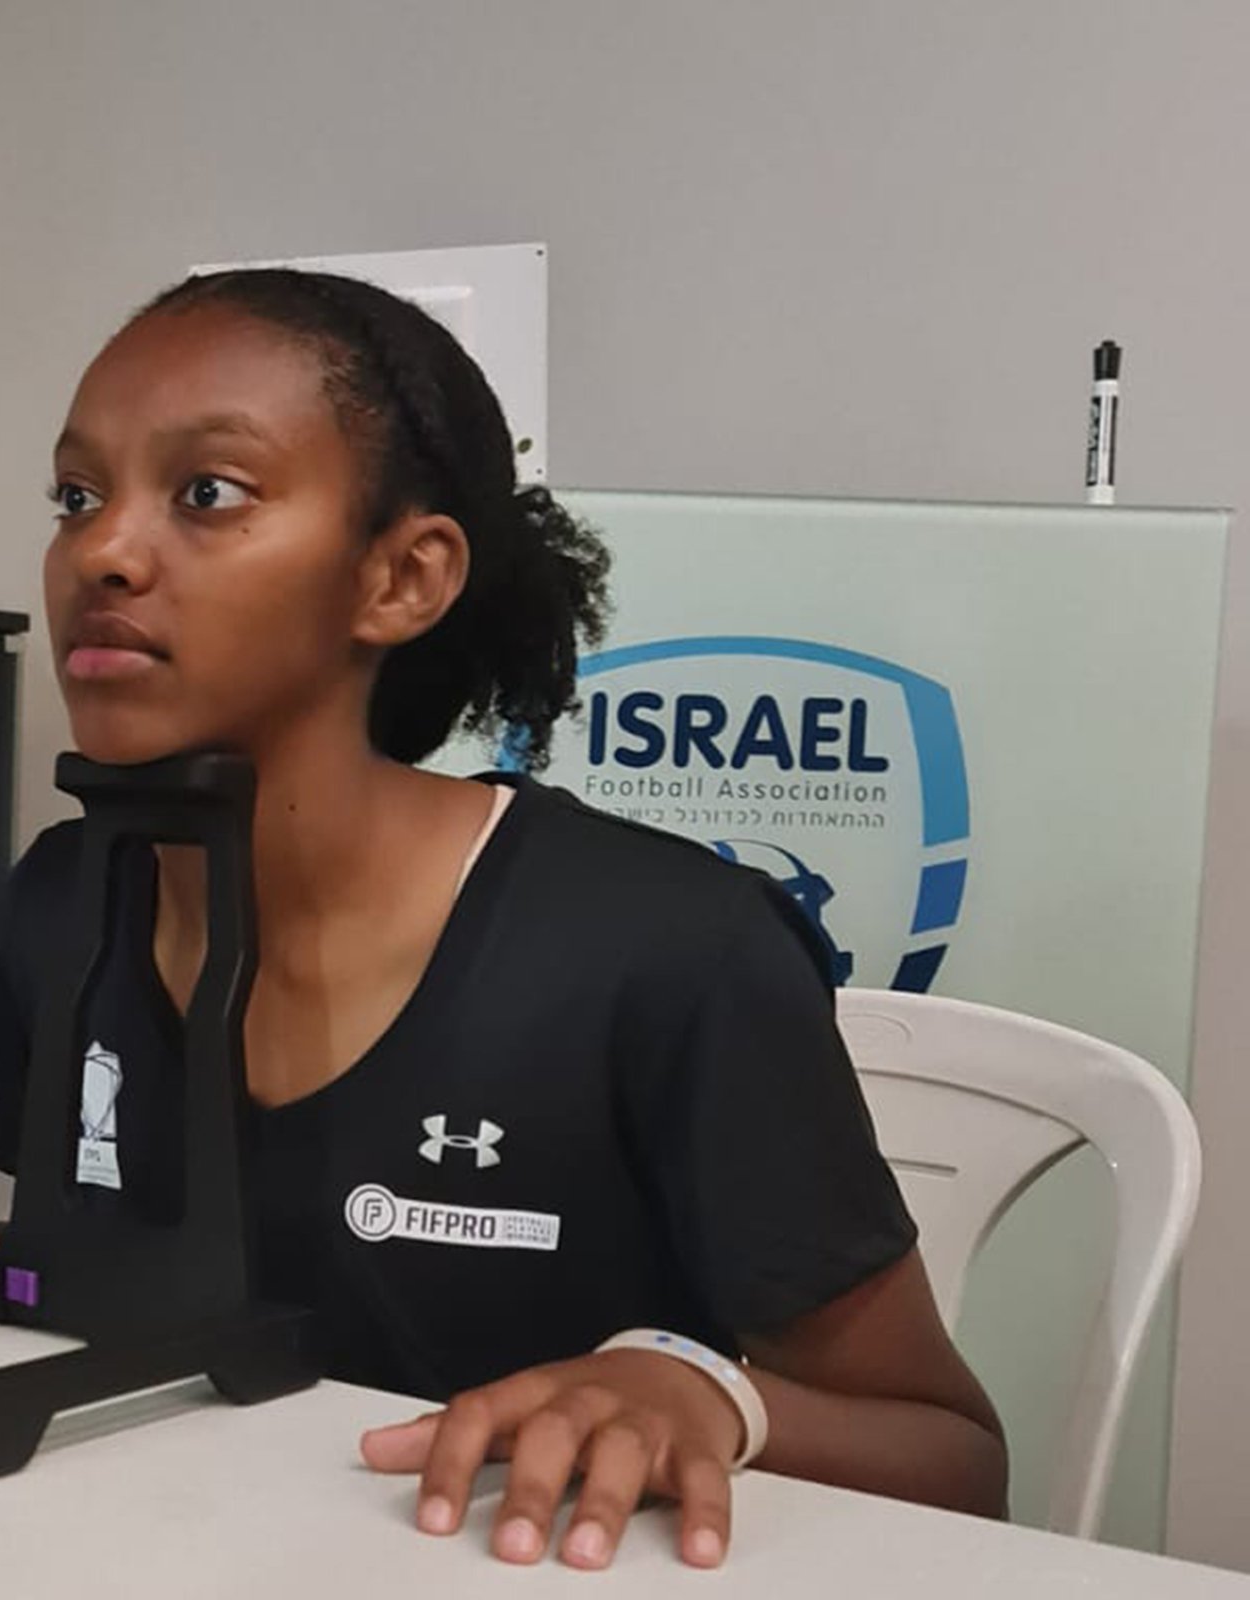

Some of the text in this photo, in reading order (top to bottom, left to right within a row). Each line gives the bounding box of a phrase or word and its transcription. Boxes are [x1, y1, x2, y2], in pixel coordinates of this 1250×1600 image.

[588, 692, 889, 773] ISRAEL
[585, 775, 887, 803] Football Association
[405, 1206, 497, 1240] FIFPRO
